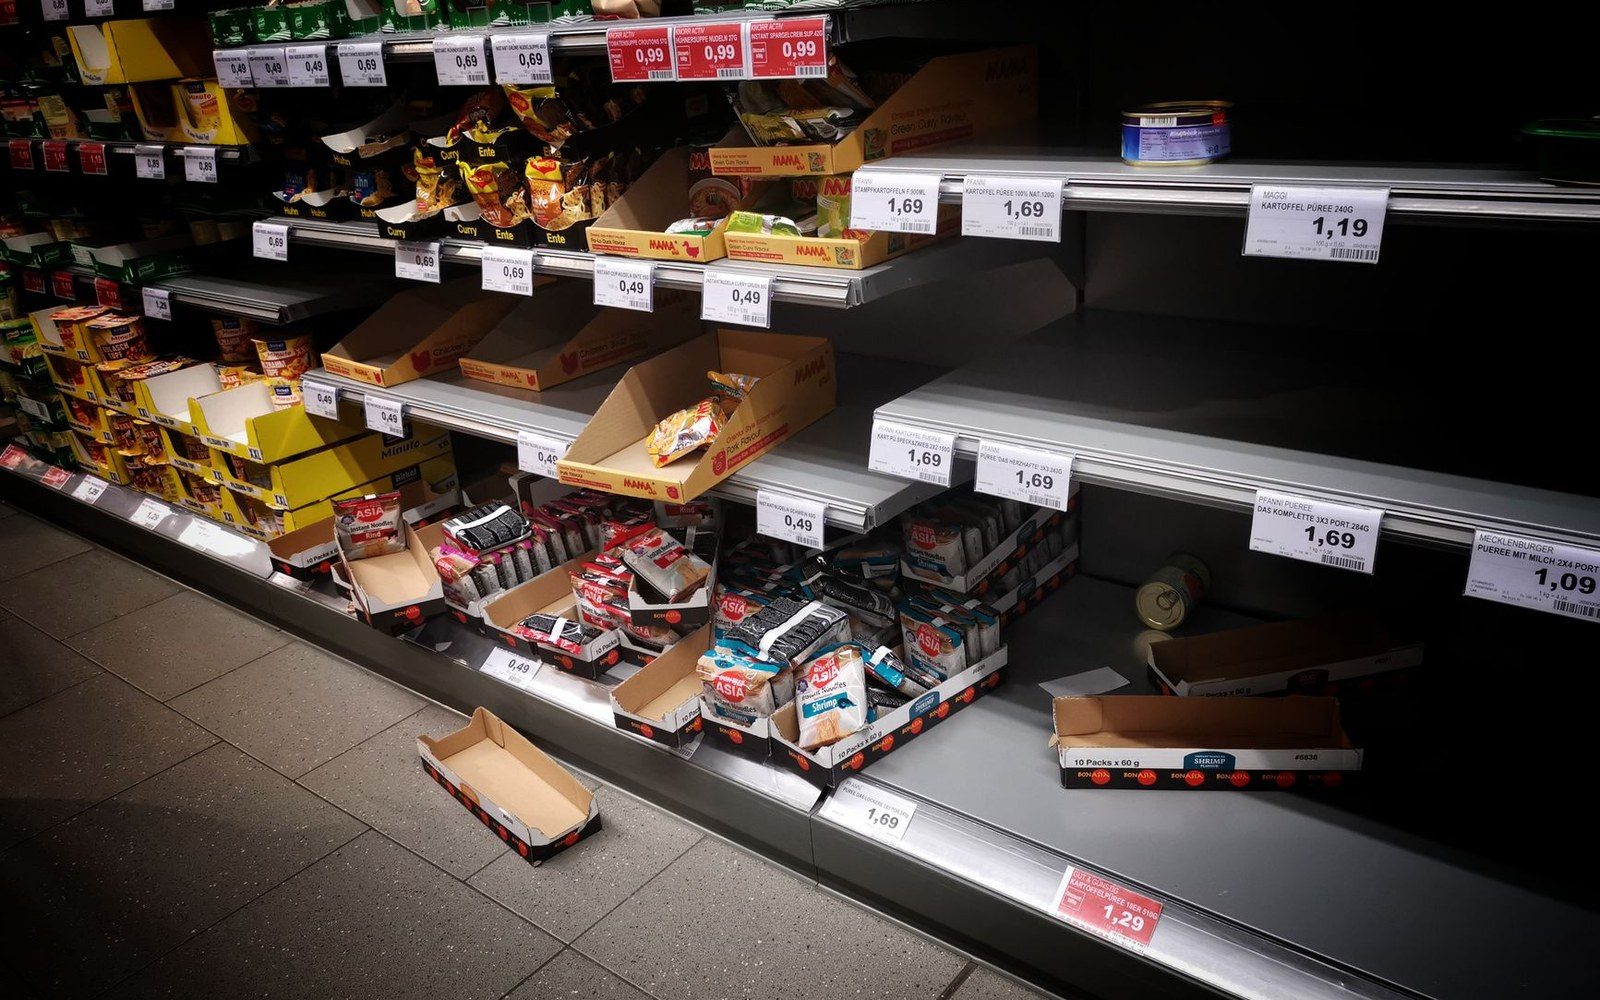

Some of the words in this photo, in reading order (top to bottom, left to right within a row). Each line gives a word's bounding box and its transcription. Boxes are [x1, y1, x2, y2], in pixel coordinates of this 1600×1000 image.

[635, 47, 664, 66] 0,99
[704, 44, 736, 63] 0,99
[782, 40, 816, 61] 0,99
[357, 59, 377, 73] 0,69
[456, 55, 478, 70] 0,69
[519, 52, 543, 69] 0,69
[231, 63, 247, 74] 0,49
[265, 62, 282, 74] 0,49
[305, 61, 323, 74] 0,49
[441, 150, 459, 161] Curry
[478, 147, 496, 158] Ente
[147, 159, 160, 170] 0,89
[198, 161, 212, 172] 0,89
[773, 155, 801, 166] MAMA
[854, 186, 906, 195] STAMPFKARTOFFELN
[965, 188, 995, 196] KARTOFFEL
[996, 188, 1014, 197] PÜREE
[1263, 191, 1288, 200] MAGGI
[283, 206, 299, 216] Huhn
[311, 208, 327, 218] Huhn
[887, 197, 923, 216] 1,69
[1003, 200, 1044, 219] 1,69
[1261, 202, 1305, 211] KARTOFFEL
[1306, 202, 1333, 213] PÜREE
[1334, 204, 1354, 213] 240G
[387, 226, 406, 239] Curry
[457, 224, 478, 236] Curry
[1312, 216, 1368, 239] 1,19
[495, 229, 514, 241] Ente
[546, 233, 566, 244] Ente
[269, 237, 284, 248] 0,69
[649, 240, 675, 250] MAMA
[796, 245, 826, 257] MAMA
[416, 255, 434, 268] 0,69
[503, 265, 524, 279] 0,69
[619, 280, 644, 295] 0,49
[732, 289, 761, 305] 0,49
[793, 356, 826, 385] MAMA
[317, 394, 333, 405] 0,49
[381, 411, 398, 424] 0,49
[381, 441, 417, 459] Minuto
[727, 442, 740, 454] Pork
[537, 453, 558, 466] 0,49
[907, 449, 941, 467] 1,69
[395, 468, 418, 484] Birkel
[1015, 470, 1054, 490] 1,69
[623, 478, 651, 491] MAMA
[88, 487, 100, 496] 1,29
[1258, 496, 1284, 507] PFANNI
[1284, 500, 1313, 512] PUEREE
[356, 507, 384, 519] ASIA
[1257, 505, 1272, 514] DAS
[1272, 508, 1315, 522] KOMPLETTE
[1316, 516, 1329, 525] 3X3
[370, 520, 394, 530] Noodles
[784, 514, 812, 532] 0,49
[365, 531, 381, 539] Rind
[911, 531, 937, 544] ASIA
[1305, 525, 1355, 549] 1,69
[1479, 534, 1555, 554] MECKLENBURGER
[313, 550, 330, 562] Packs
[1477, 544, 1511, 557] PUEREE
[1512, 551, 1527, 560] MIT
[1528, 554, 1556, 565] MILCH
[1557, 559, 1573, 568] 2X4
[1535, 568, 1597, 595] 1,09
[720, 601, 746, 615] ASIA
[602, 639, 617, 651] Packs
[916, 633, 941, 653] ASIA
[508, 658, 530, 674] 0,49
[811, 667, 841, 684] ASIA
[716, 682, 746, 698] ASIA
[812, 698, 838, 713] Shrimp
[681, 713, 689, 723] 10
[838, 751, 846, 759] 10
[846, 741, 864, 756] Packs
[869, 733, 877, 742] 60
[1086, 758, 1112, 766] Packs
[1194, 757, 1226, 765] SHRIMP
[868, 808, 899, 829] 1,69
[1072, 870, 1087, 880] GUT
[1069, 878, 1126, 906] KARTOFFELPÜREE
[1103, 904, 1145, 932] 1,29
